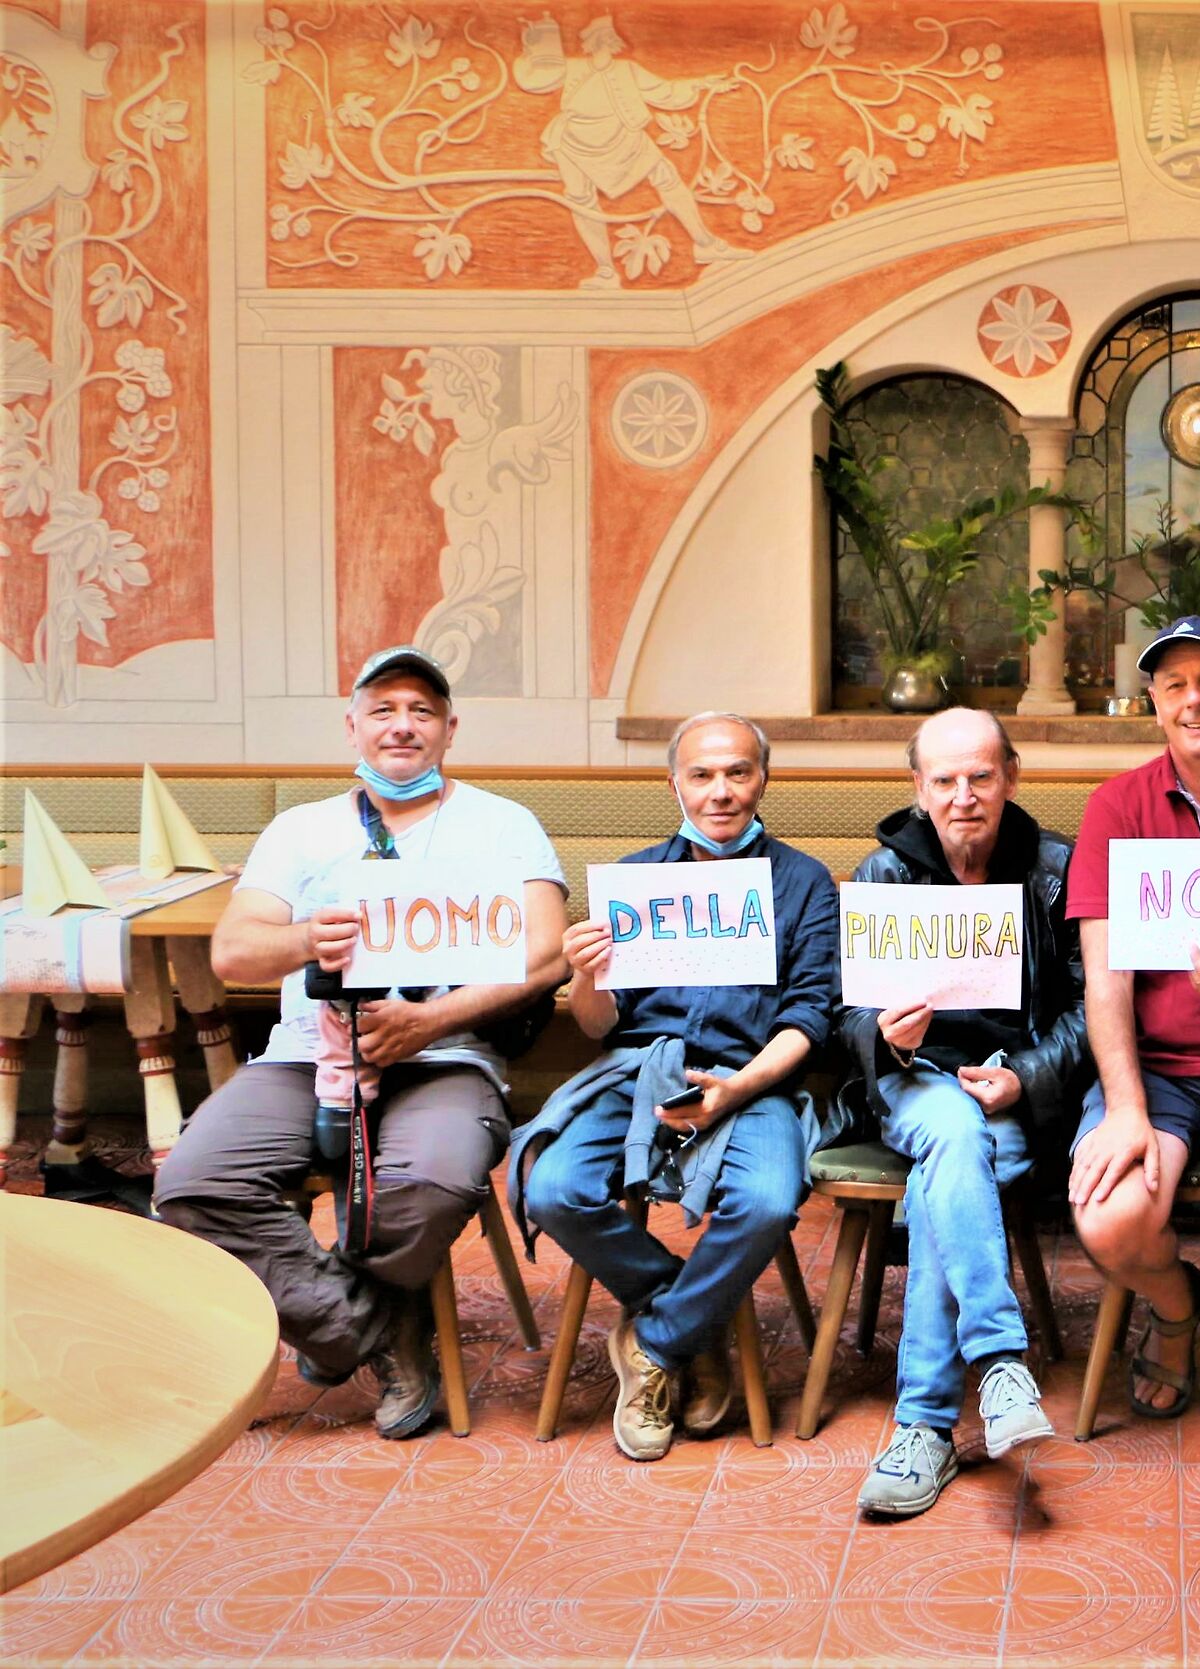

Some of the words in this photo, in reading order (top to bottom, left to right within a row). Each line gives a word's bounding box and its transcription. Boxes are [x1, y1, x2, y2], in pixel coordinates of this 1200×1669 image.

[359, 894, 522, 953] UOMO
[609, 889, 770, 943] DELLA
[846, 911, 1020, 959] PIANURA
